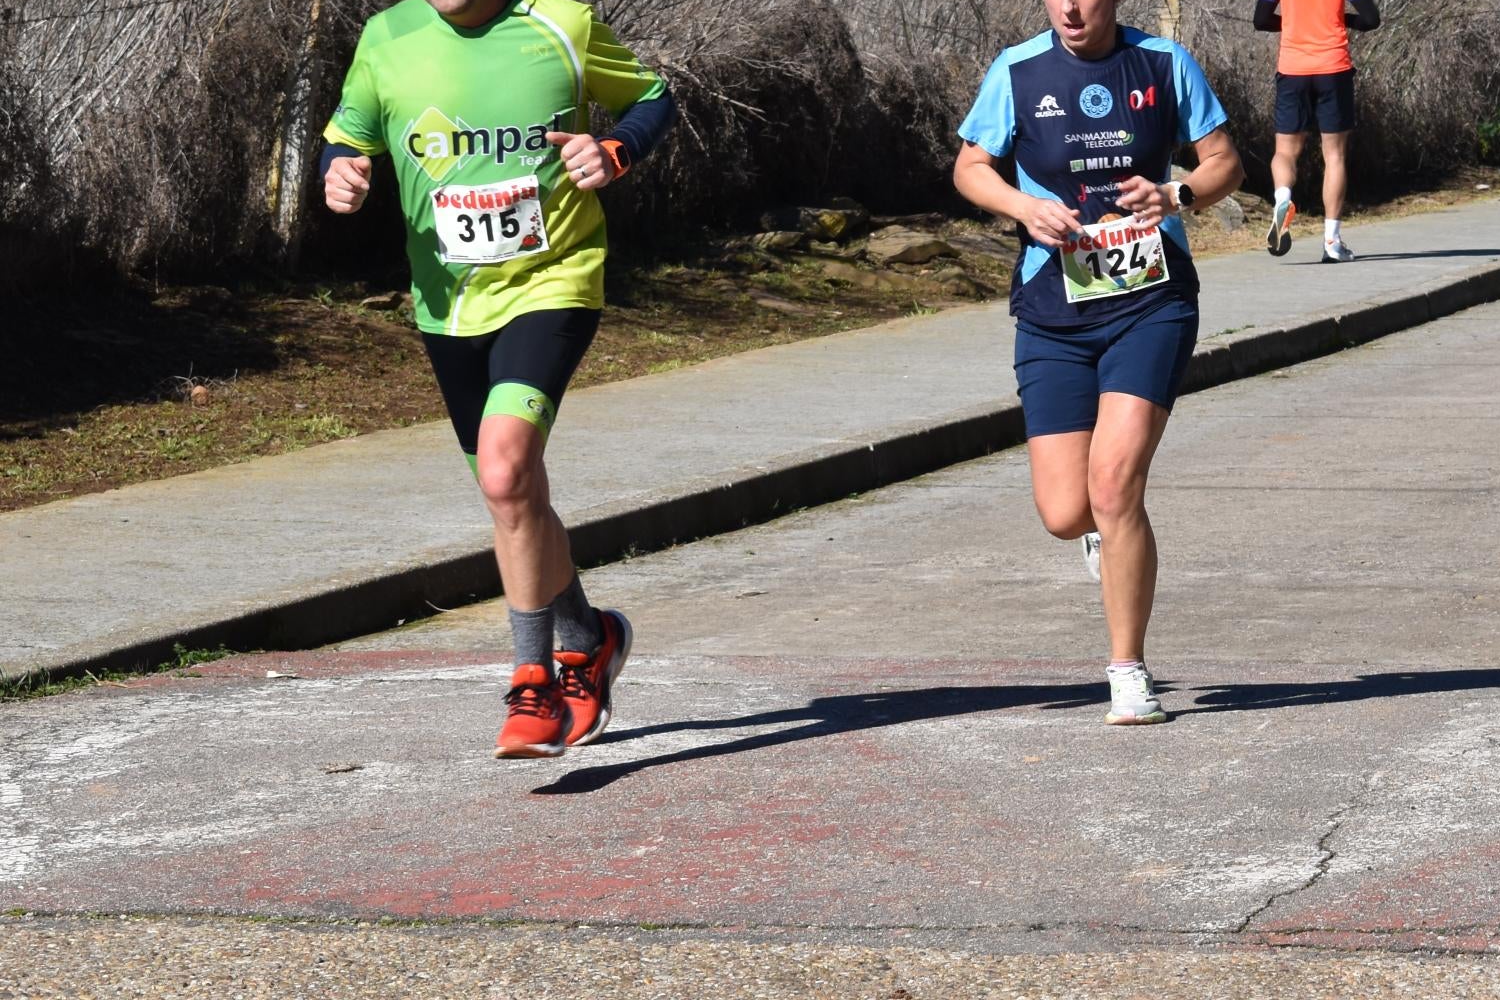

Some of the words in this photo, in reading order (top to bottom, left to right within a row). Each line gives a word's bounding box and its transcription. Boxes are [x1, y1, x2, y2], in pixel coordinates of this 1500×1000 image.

[1085, 140, 1124, 149] TELECOM
[1085, 156, 1133, 170] MILAR
[456, 208, 520, 243] 315
[1085, 242, 1148, 279] 124
